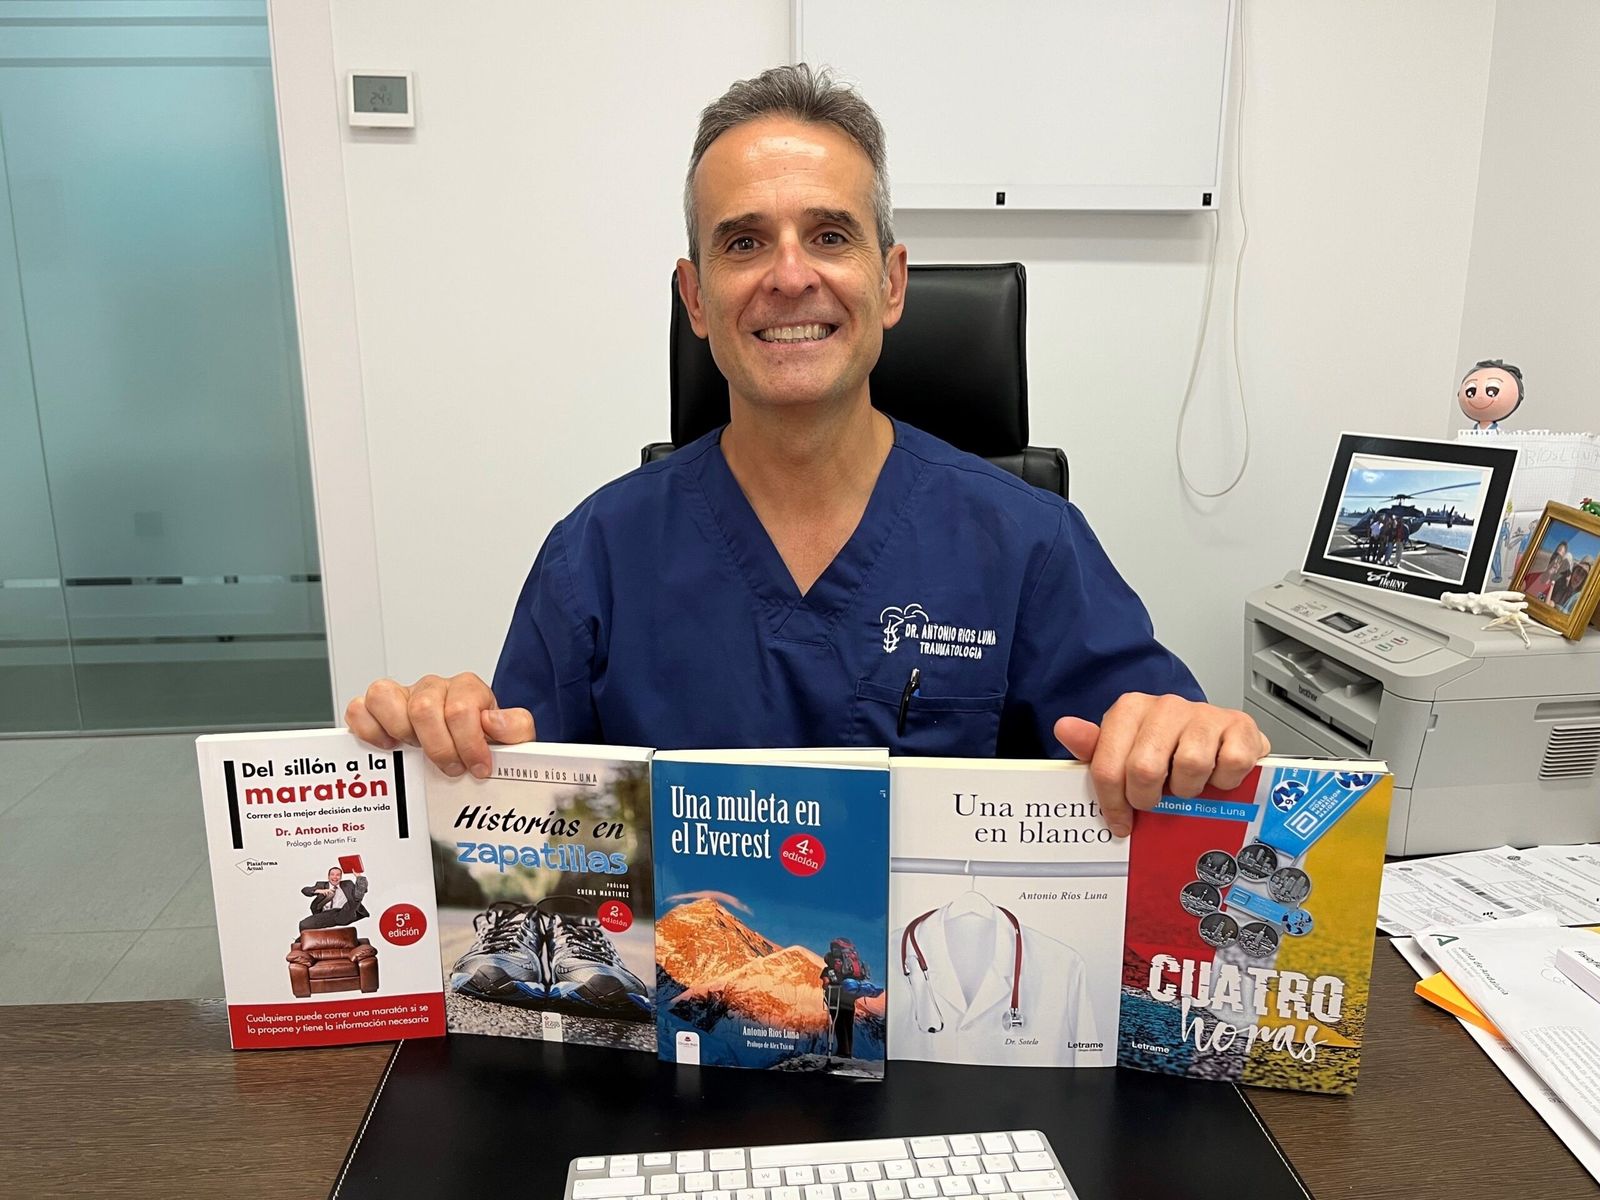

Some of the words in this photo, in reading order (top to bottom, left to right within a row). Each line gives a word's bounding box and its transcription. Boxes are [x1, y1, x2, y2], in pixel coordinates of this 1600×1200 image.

[905, 624, 918, 638] DR.
[922, 624, 956, 642] ANTONIO
[958, 628, 975, 643] RIOS
[977, 630, 996, 645] LUNA
[920, 642, 982, 659] TRAUMATOLOGIA
[242, 760, 274, 778] Del
[284, 758, 336, 776] sillón
[346, 760, 359, 772] a
[368, 754, 387, 770] la
[498, 768, 538, 779] ANTONIO
[545, 768, 567, 781] RÍOS
[574, 773, 597, 783] LUNA
[245, 774, 388, 805] maratón
[294, 809, 316, 818] mejor
[318, 806, 350, 815] decisión
[670, 785, 711, 820] Una
[717, 790, 789, 825] muleta
[796, 800, 821, 826] en
[954, 794, 1014, 817] Una
[1155, 802, 1192, 811] ntonio
[1221, 806, 1245, 816] Luna
[276, 828, 291, 836] Dr.
[295, 824, 338, 836] Antonio
[454, 805, 580, 837] Historias
[593, 821, 624, 839] en
[975, 828, 1007, 843] en
[1019, 821, 1112, 843] blanco
[672, 822, 690, 854] el
[695, 823, 771, 859] Everest
[456, 842, 629, 874] zapatillas
[782, 849, 819, 870] edición
[1019, 891, 1057, 900] Antonio
[1061, 891, 1081, 900] Ríos
[395, 912, 410, 928] 5ª
[602, 917, 627, 927] edición
[388, 926, 419, 938] edición
[1147, 954, 1345, 1022] CUATRO
[246, 1013, 293, 1024] Cualquiera
[295, 1011, 322, 1023] puede
[372, 1006, 408, 1015] maratón
[248, 1025, 256, 1034] lo
[258, 1026, 294, 1036] propone
[325, 1022, 333, 1030] la
[336, 1019, 386, 1030] información
[388, 1015, 429, 1025] necesaria
[743, 1026, 767, 1037] Antonio
[784, 1029, 799, 1039] Luna
[1182, 996, 1328, 1063] horas
[1132, 1041, 1170, 1053] Letrame
